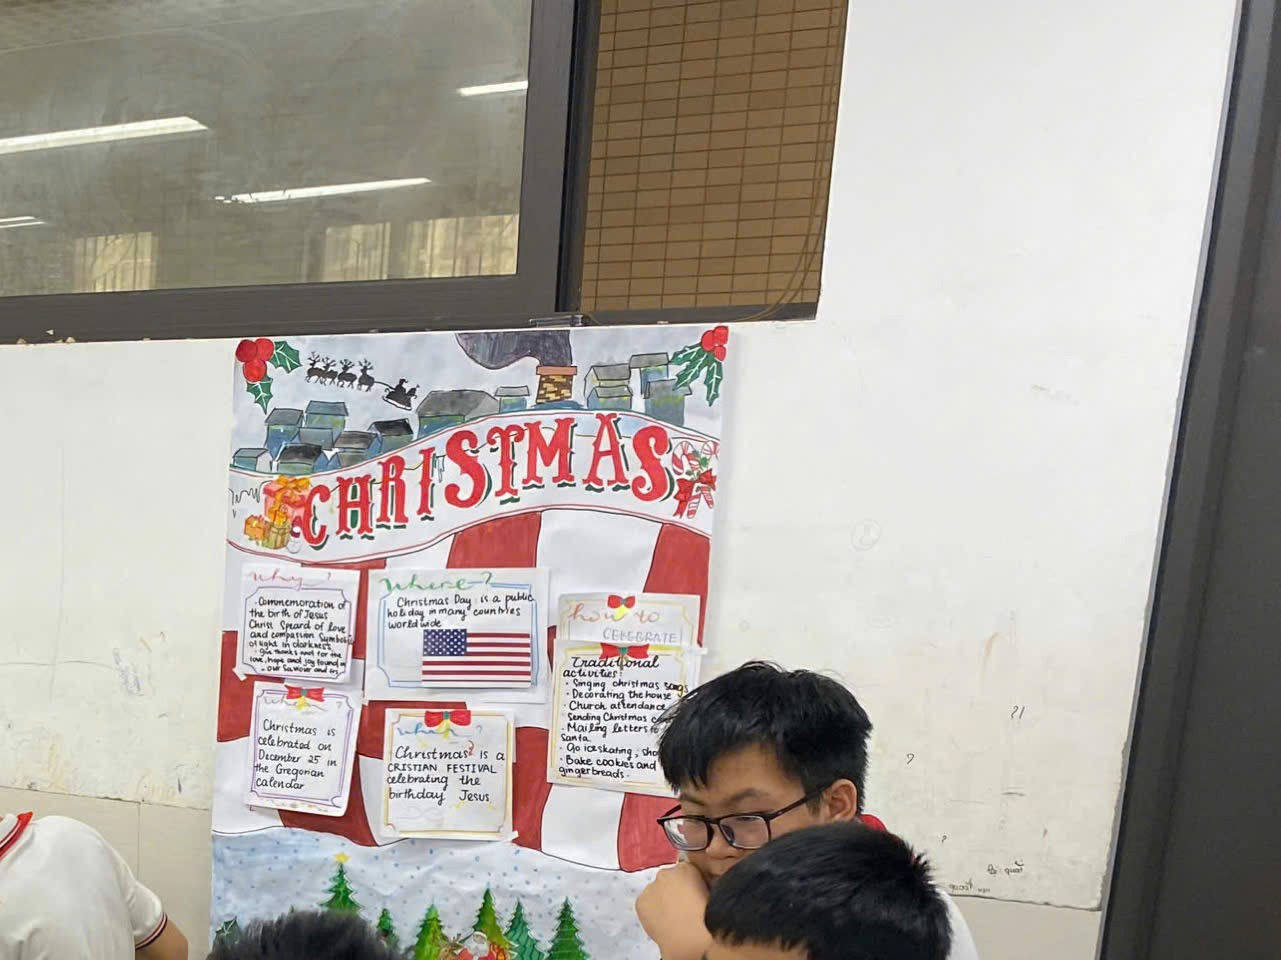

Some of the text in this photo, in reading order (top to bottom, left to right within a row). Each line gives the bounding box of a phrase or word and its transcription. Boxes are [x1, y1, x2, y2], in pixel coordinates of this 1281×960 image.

[301, 413, 675, 546] CHRISTMAS
[259, 596, 334, 609] Commemoration
[397, 592, 535, 610] Christmas Day is a public
[249, 609, 328, 620] the birth of Jesus
[387, 608, 424, 620] holiday
[438, 608, 466, 621] many
[473, 606, 521, 616] countries
[250, 630, 268, 638] and
[315, 622, 324, 630] of
[328, 622, 346, 633] love
[304, 659, 315, 667] joy
[317, 658, 338, 667] found
[572, 679, 606, 692] Singing
[664, 681, 688, 697] sogs
[572, 688, 671, 701] Decorating the house
[569, 700, 666, 711] Church attendance
[568, 712, 601, 725] Sending
[603, 712, 647, 723] Christmas
[263, 719, 336, 736] Christmas is
[567, 723, 606, 737] Mailing
[612, 723, 647, 733] letters
[258, 735, 310, 750] celebrated
[259, 749, 301, 762] December
[308, 756, 320, 764] 25
[395, 746, 505, 760] Christmas is a
[566, 743, 580, 753] Go
[642, 748, 658, 757] sho
[388, 763, 498, 773] CRISTIAN FESTIVAL
[566, 755, 656, 771] Bake cookies and
[254, 764, 324, 780] the Gregorian
[256, 777, 305, 789] calendar
[387, 773, 481, 791] celebrating the
[389, 787, 445, 806] birthday
